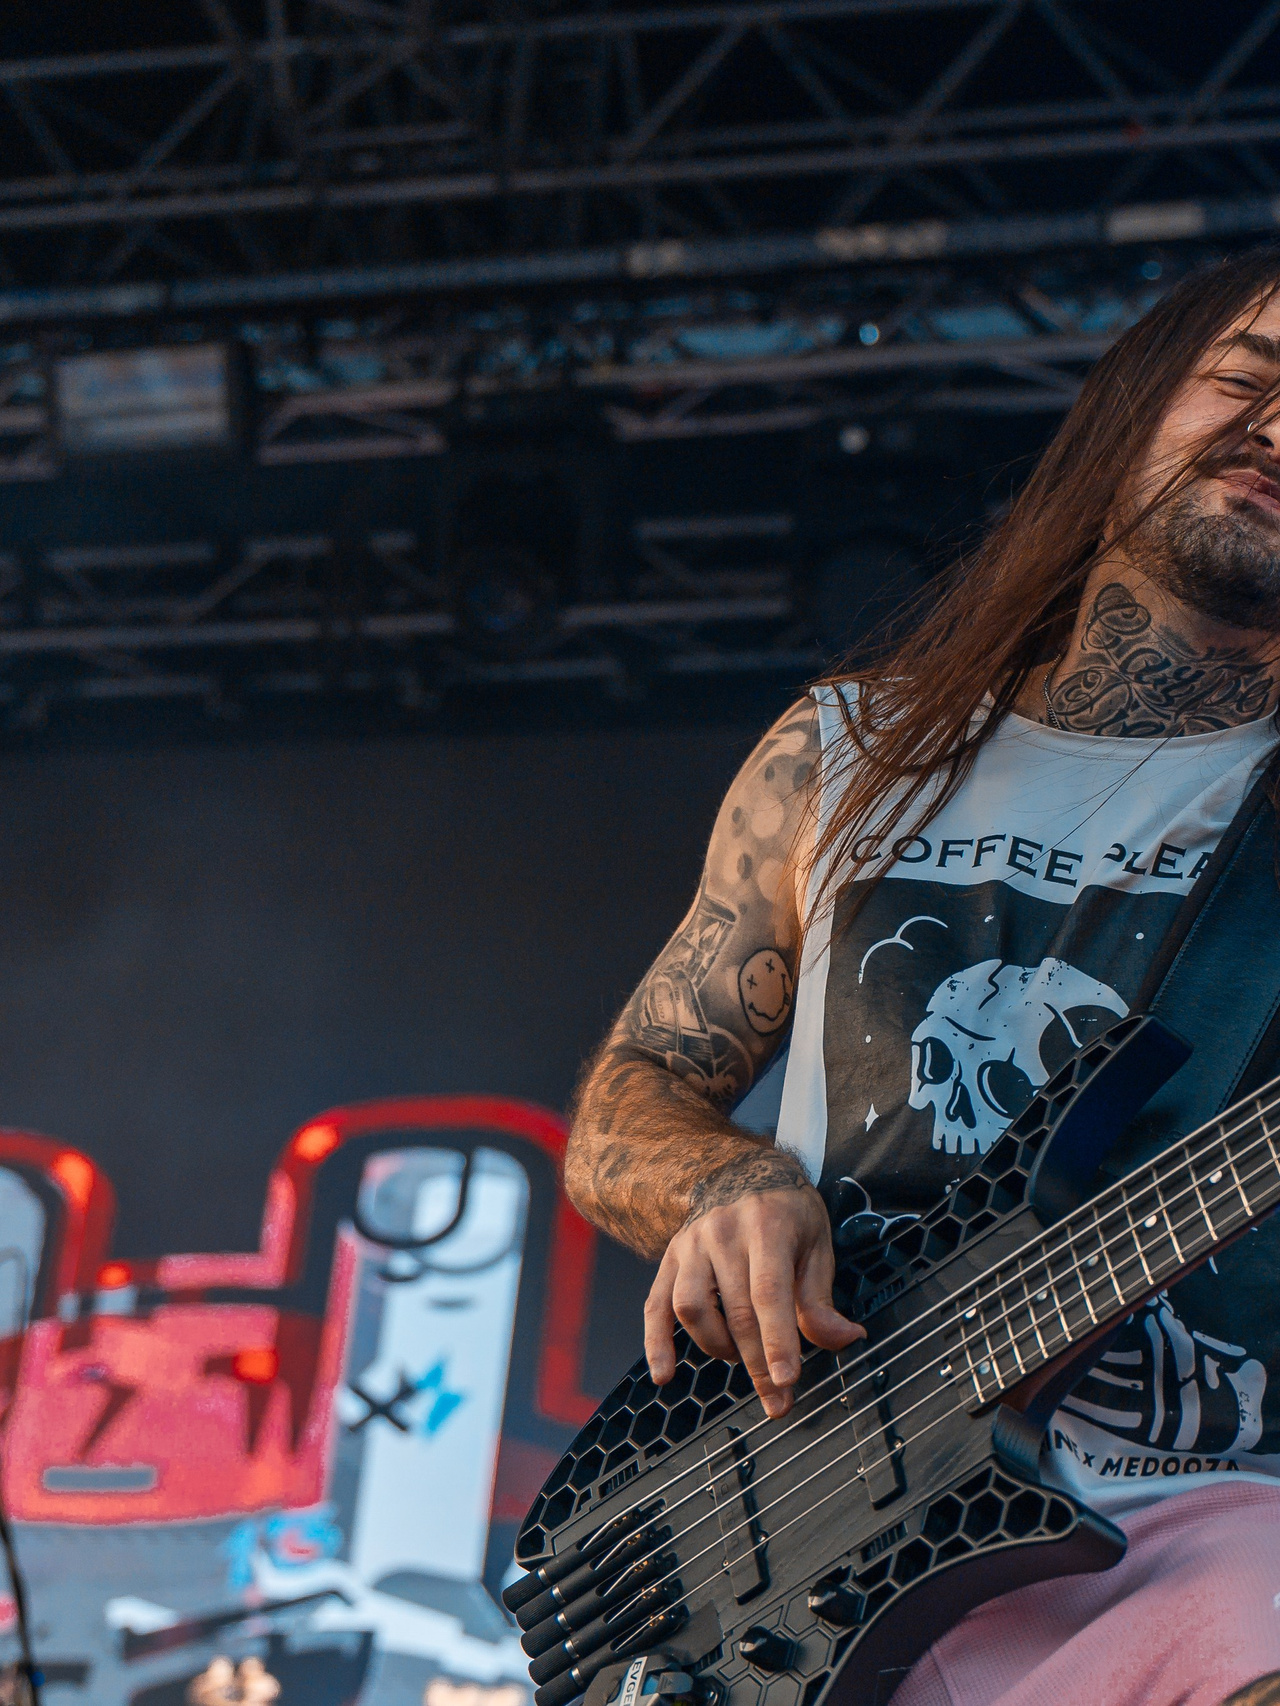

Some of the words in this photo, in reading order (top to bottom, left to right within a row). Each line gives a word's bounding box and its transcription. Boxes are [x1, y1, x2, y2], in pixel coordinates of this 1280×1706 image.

[850, 833, 1084, 888] COFFEE
[1099, 1456, 1240, 1477] MEDOOZA
[623, 1660, 643, 1706] EVGE
